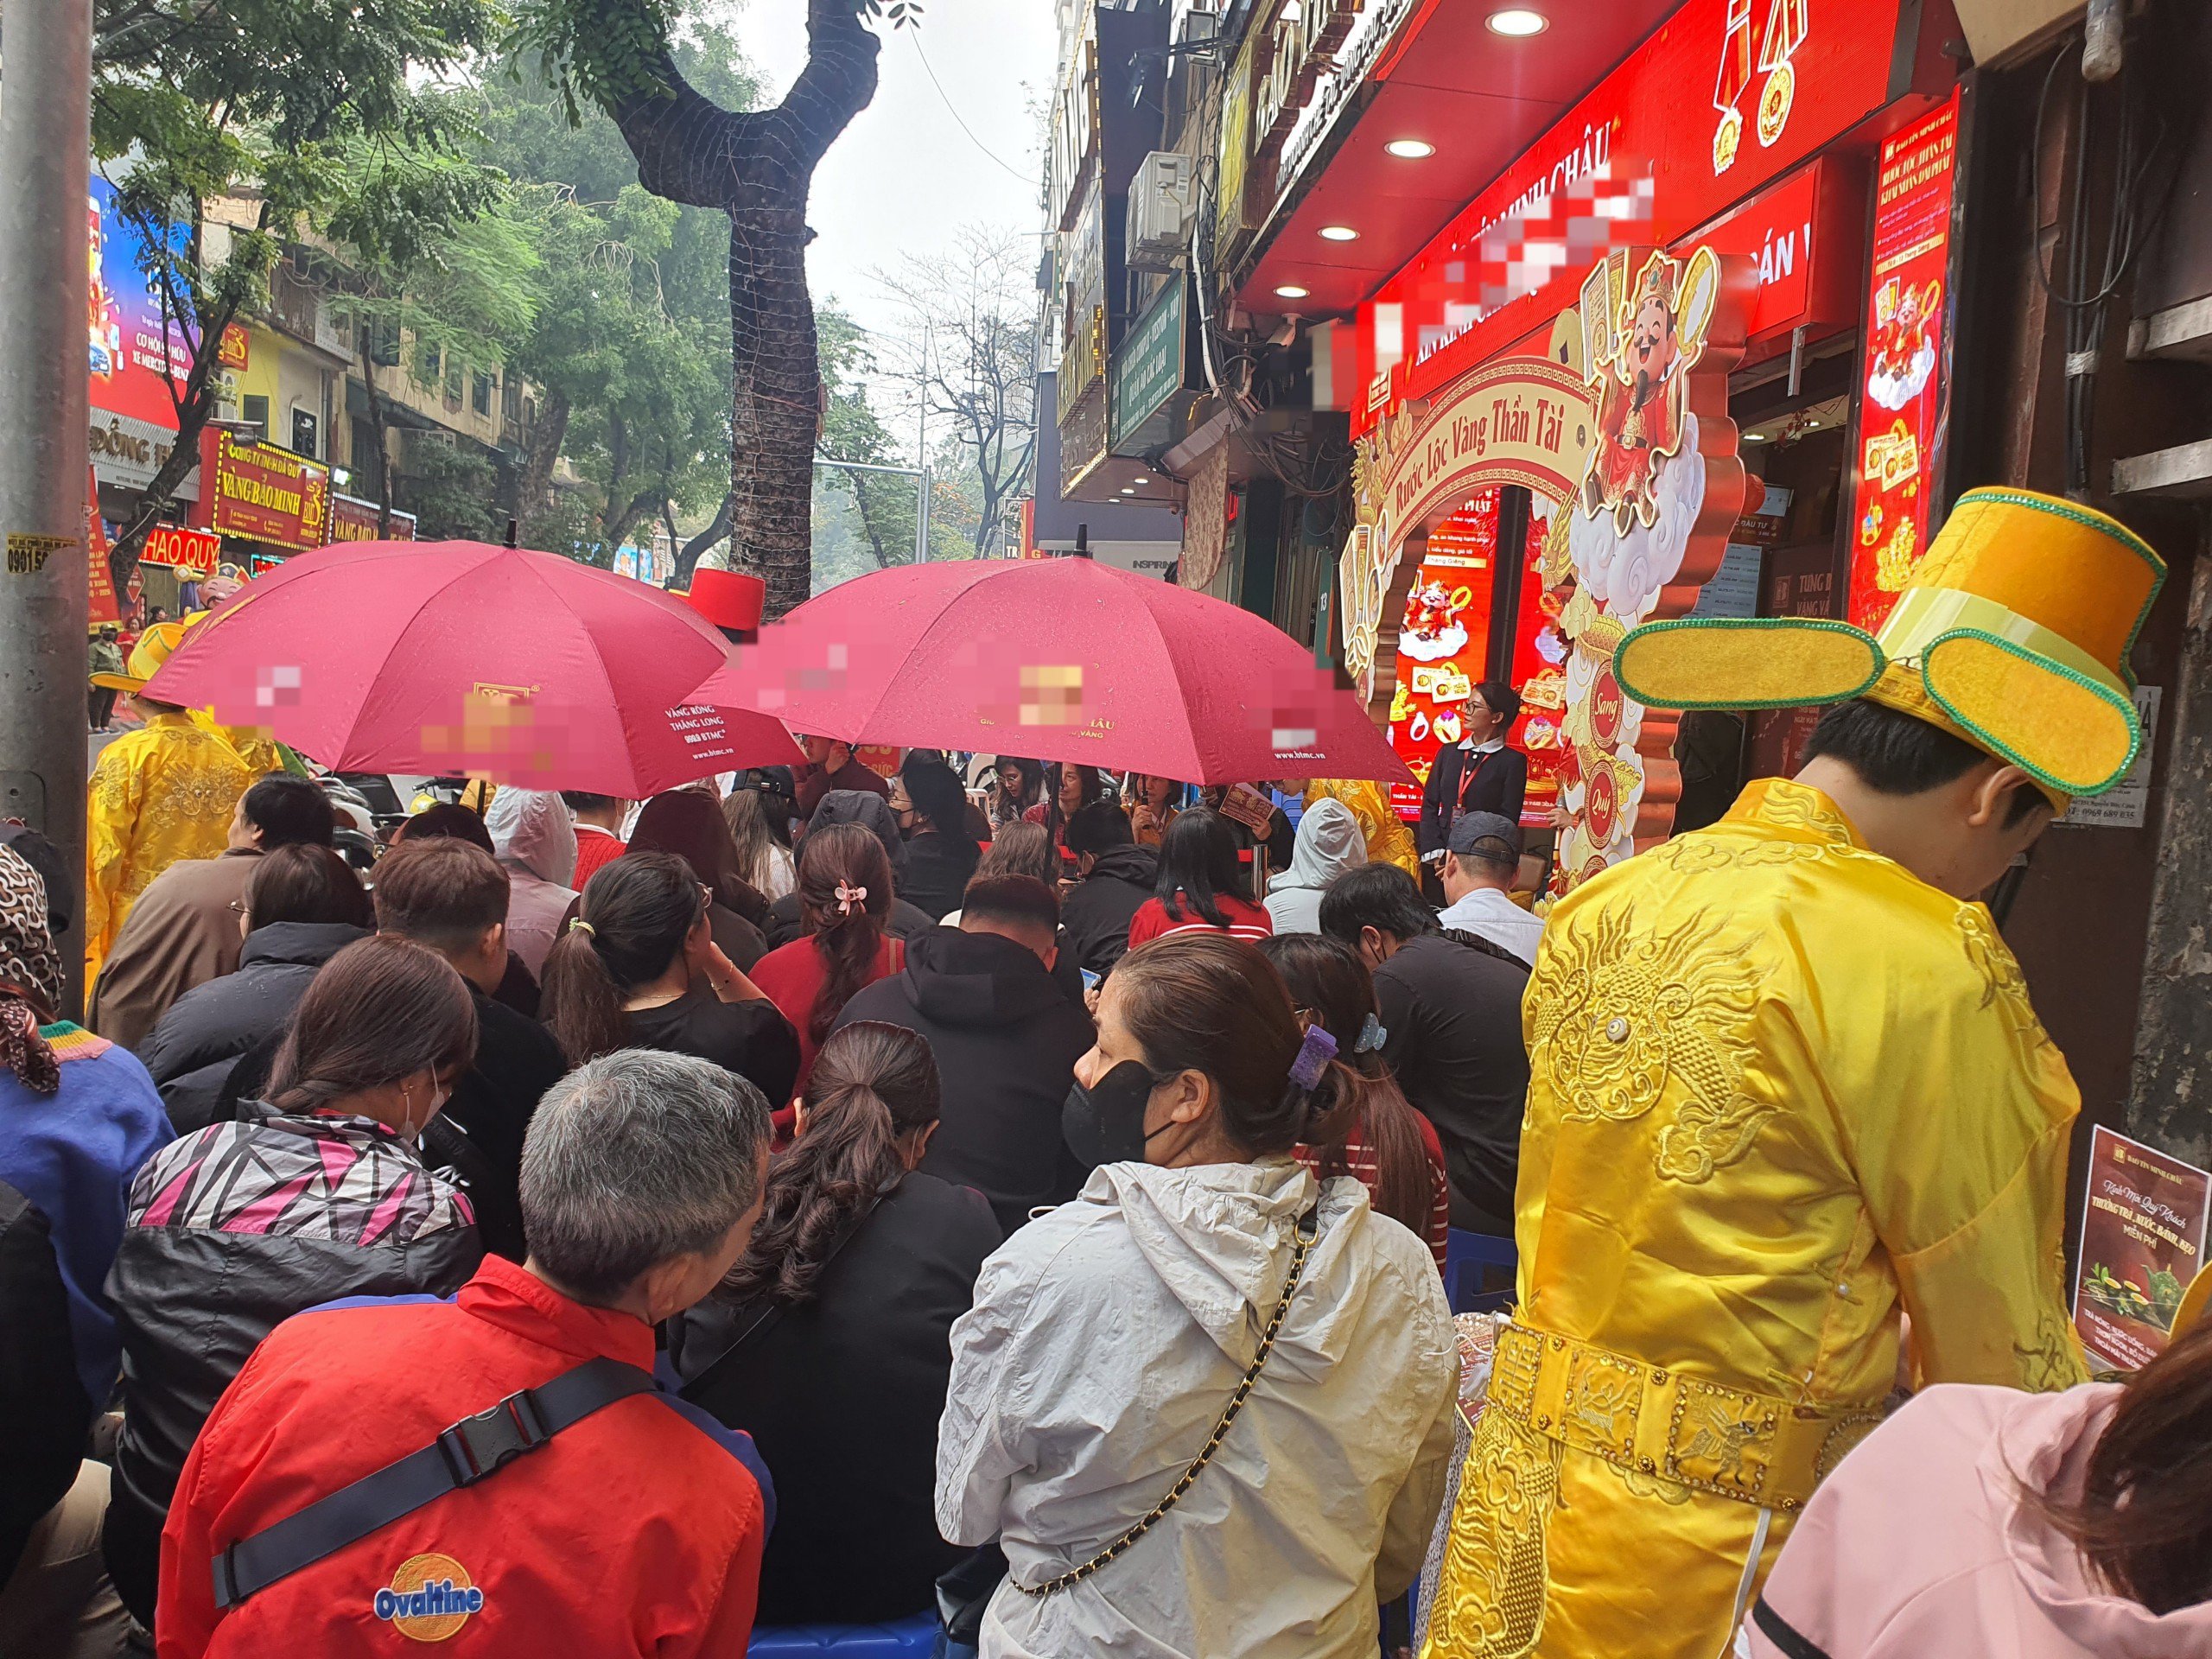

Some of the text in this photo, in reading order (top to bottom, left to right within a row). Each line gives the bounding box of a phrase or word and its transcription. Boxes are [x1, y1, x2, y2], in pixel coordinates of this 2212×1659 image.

[1395, 394, 1566, 518] Rước Lộc Vàng Thần Tài
[222, 466, 302, 516] VÀNG BẢO MINH
[1006, 545, 1020, 558] TR
[664, 707, 690, 719] VÀNG
[700, 716, 724, 727] LONG
[1595, 692, 1618, 722] Sang
[692, 747, 734, 760] www.btmc.vn
[1274, 751, 1325, 760] www.btmc.vn
[1592, 788, 1611, 820] Quý
[2140, 1196, 2159, 1215] Quý
[2158, 1204, 2186, 1228] Khách
[373, 1577, 484, 1621] Ovaltine
